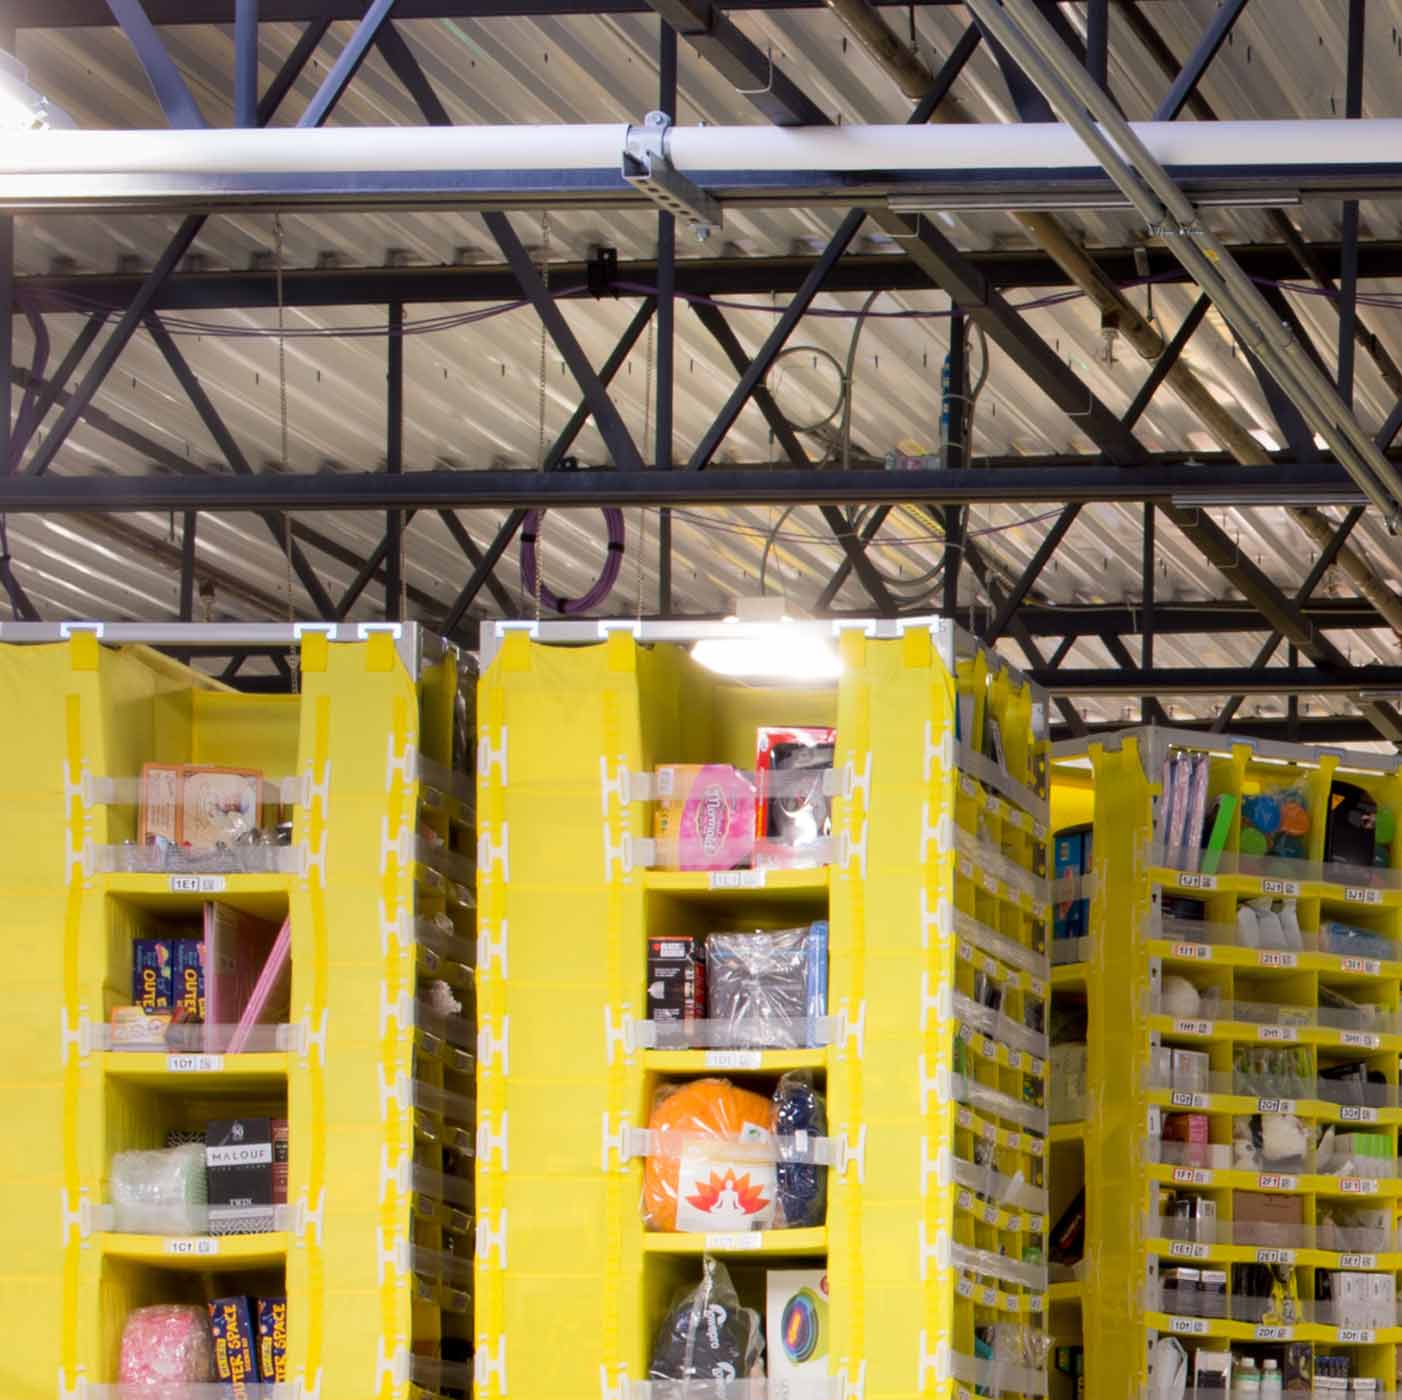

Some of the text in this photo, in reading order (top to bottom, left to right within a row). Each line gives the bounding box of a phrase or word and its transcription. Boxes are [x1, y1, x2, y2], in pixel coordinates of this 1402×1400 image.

[143, 968, 157, 1008] OUTE
[212, 1149, 265, 1162] MALOUF
[223, 1304, 241, 1350] SPACE
